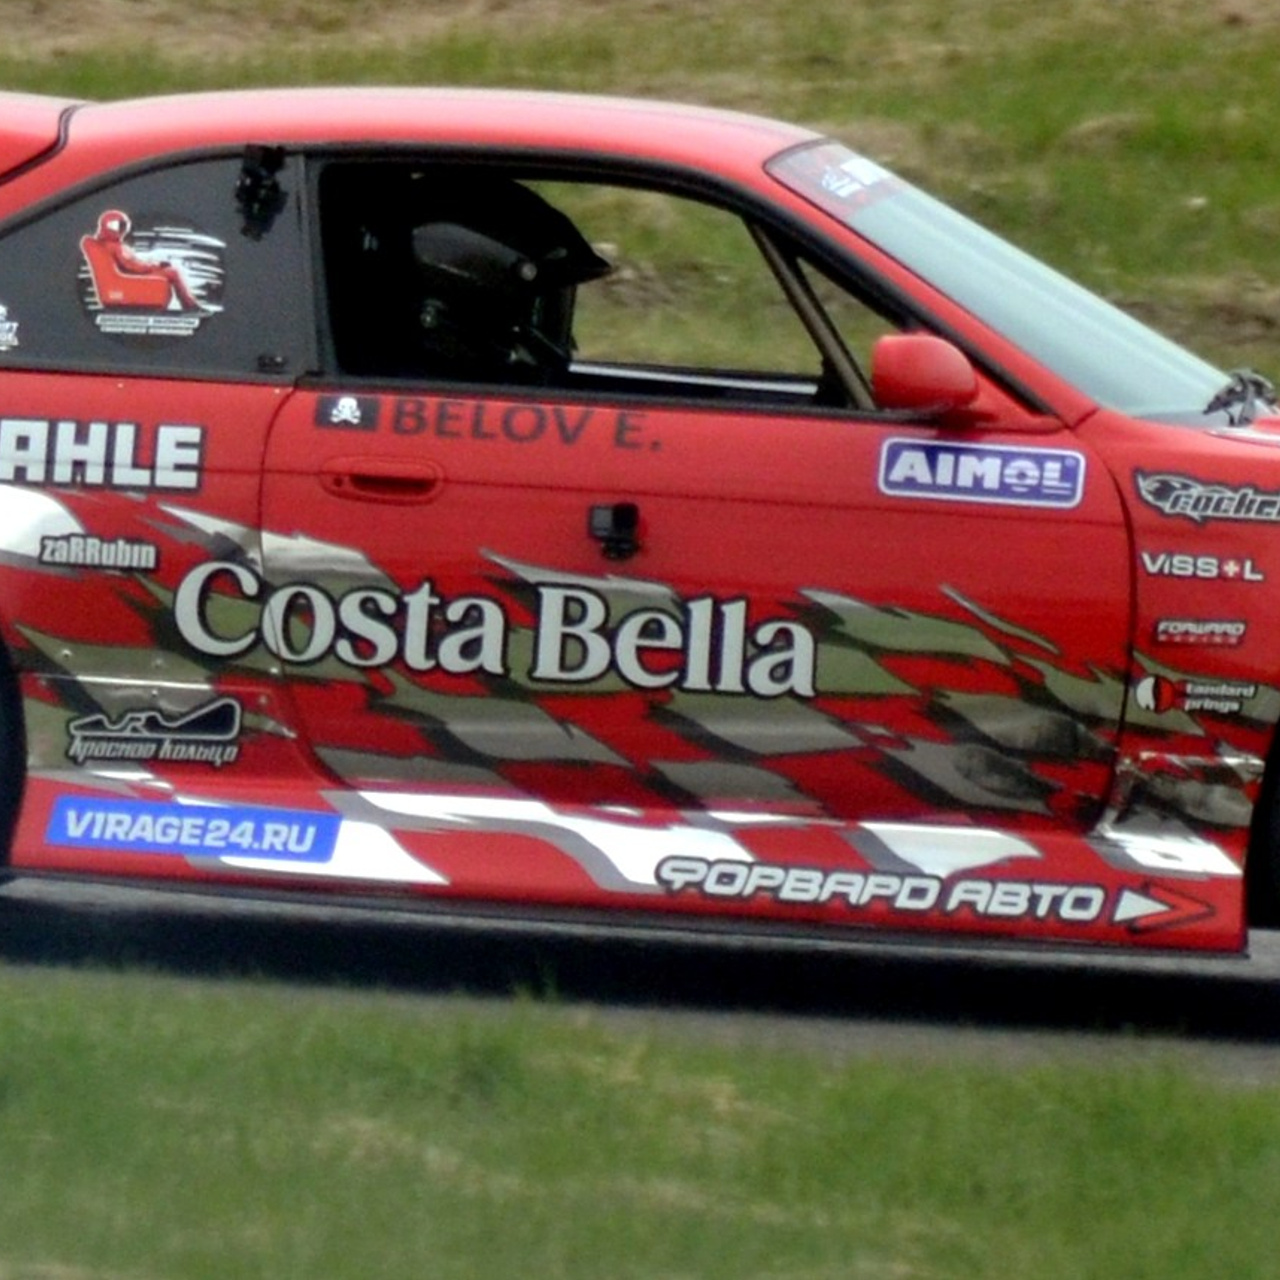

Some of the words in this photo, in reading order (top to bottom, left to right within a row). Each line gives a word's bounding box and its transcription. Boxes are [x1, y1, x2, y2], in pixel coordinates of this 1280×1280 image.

[392, 397, 596, 446] BELOV
[614, 412, 663, 452] E.
[888, 449, 1074, 496] AIMOL
[174, 561, 506, 676] Costa
[530, 584, 816, 698] Bella
[65, 809, 317, 854] VIRAGE24.RU
[659, 859, 937, 910] ФОРВАРД
[947, 879, 1105, 920] АВТО
